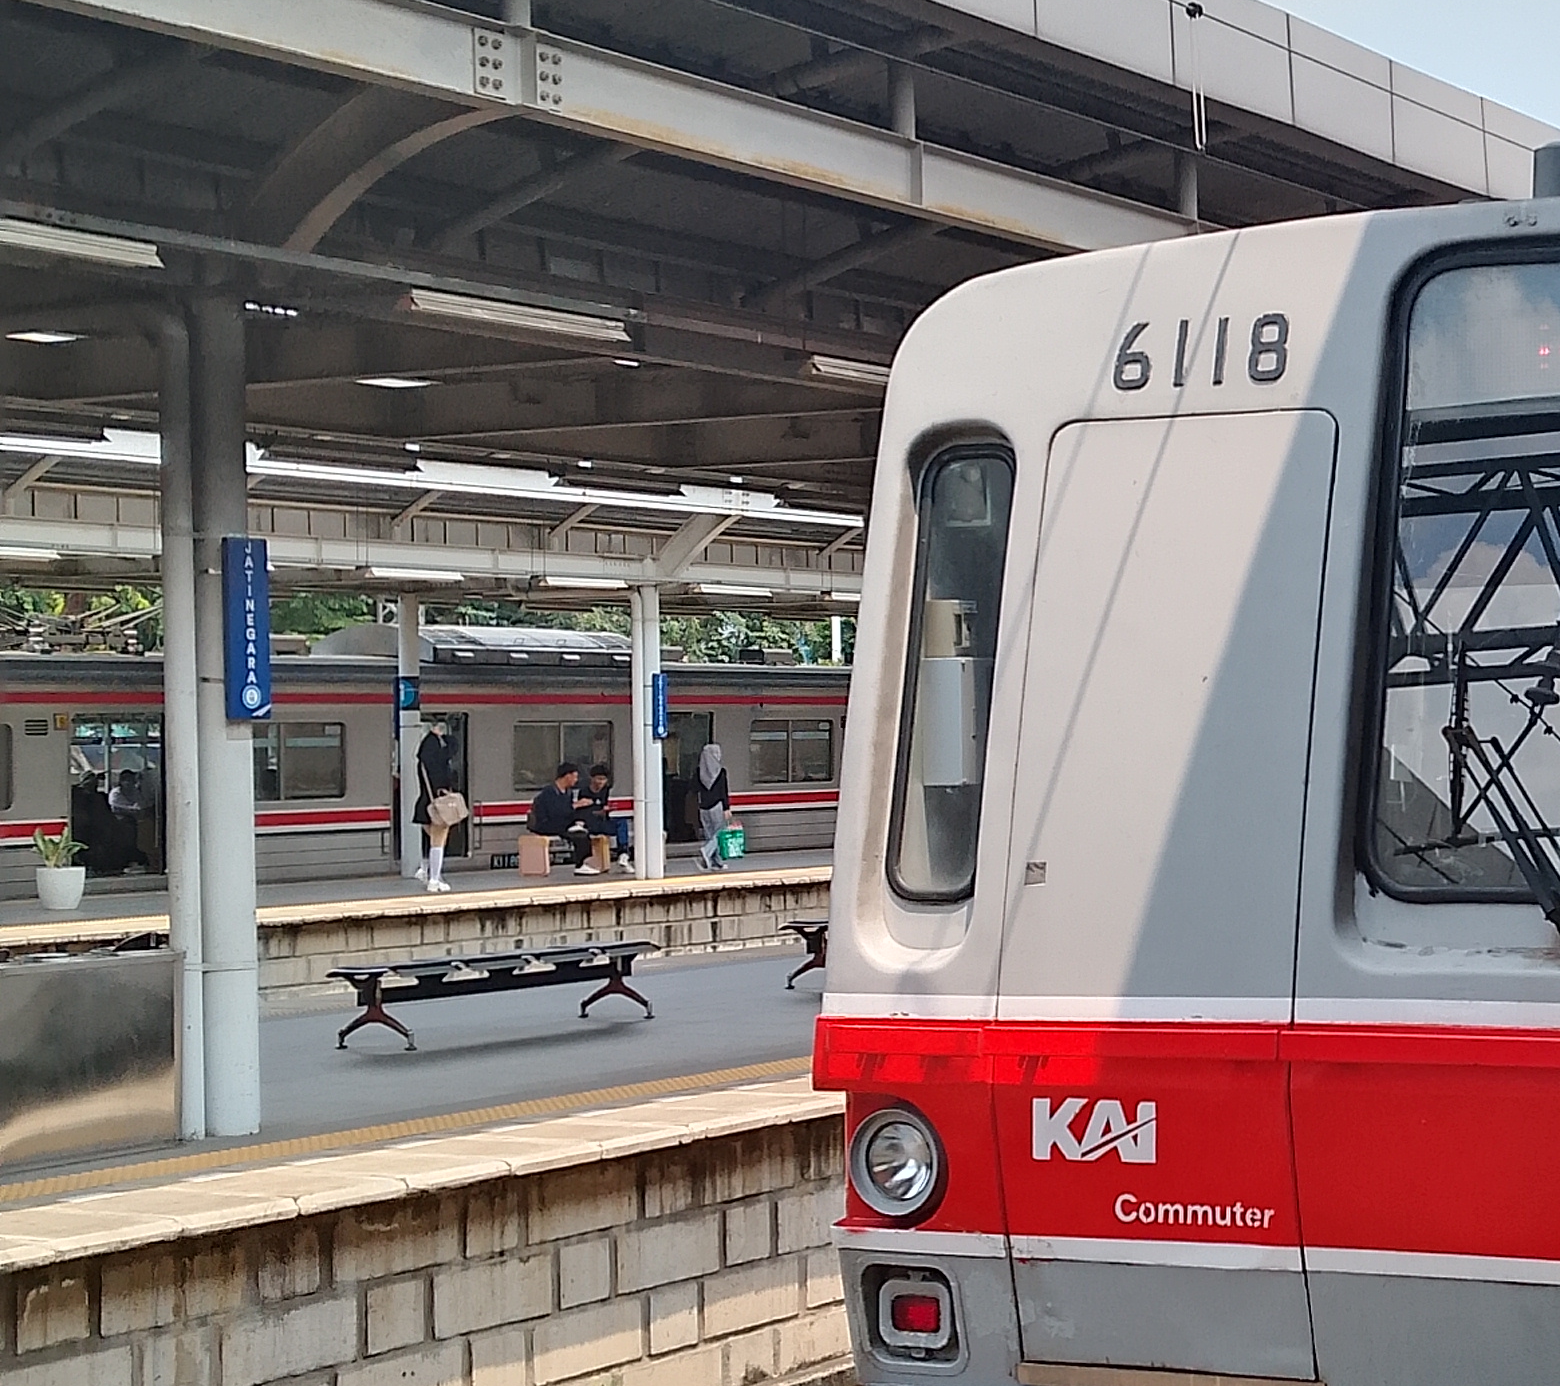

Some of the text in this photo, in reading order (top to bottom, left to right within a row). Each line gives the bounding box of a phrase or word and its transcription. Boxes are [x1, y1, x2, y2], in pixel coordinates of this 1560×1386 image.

[1113, 312, 1289, 391] 6118
[244, 542, 257, 684] JATINEGARA
[1032, 1097, 1157, 1164] KAI
[1114, 1193, 1275, 1228] Commuter
